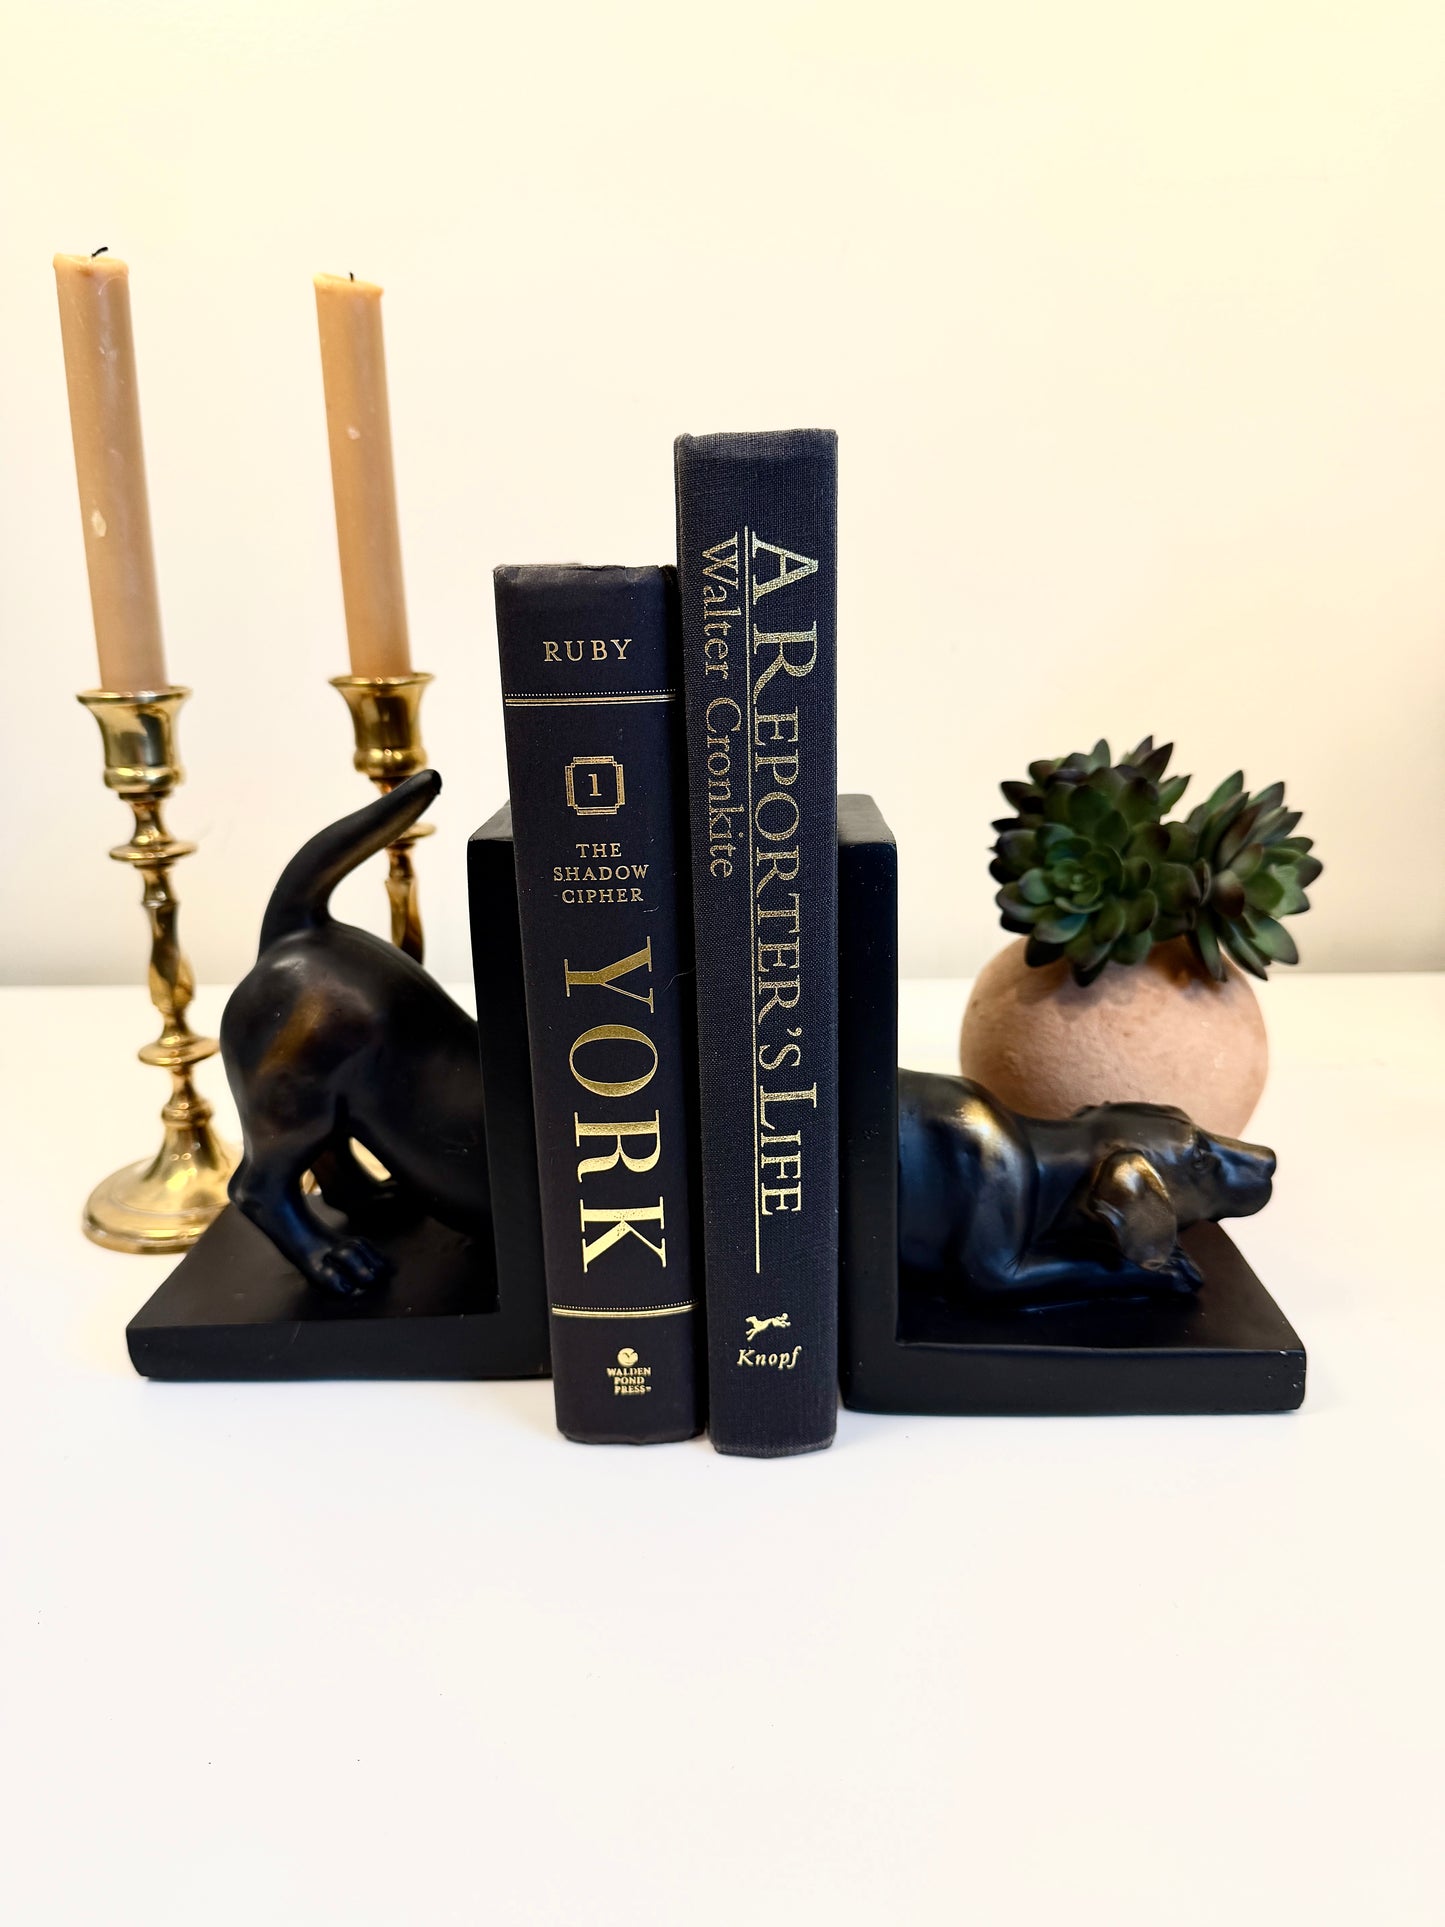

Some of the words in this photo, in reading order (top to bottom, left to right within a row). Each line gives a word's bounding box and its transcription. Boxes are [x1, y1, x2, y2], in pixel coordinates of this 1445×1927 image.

[752, 530, 818, 605] A
[702, 531, 742, 680] Walter
[543, 638, 632, 662] RUBY
[588, 773, 602, 797] 1
[705, 697, 745, 879] Cronkite
[575, 843, 622, 858] THE
[553, 864, 649, 882] SHADOW
[561, 888, 645, 904] CIPHER
[564, 936, 667, 1273] YORK
[759, 1082, 817, 1215] LIFE
[737, 1345, 802, 1370] Knopf
[607, 1367, 651, 1377] WALDEN
[614, 1376, 645, 1386] POND
